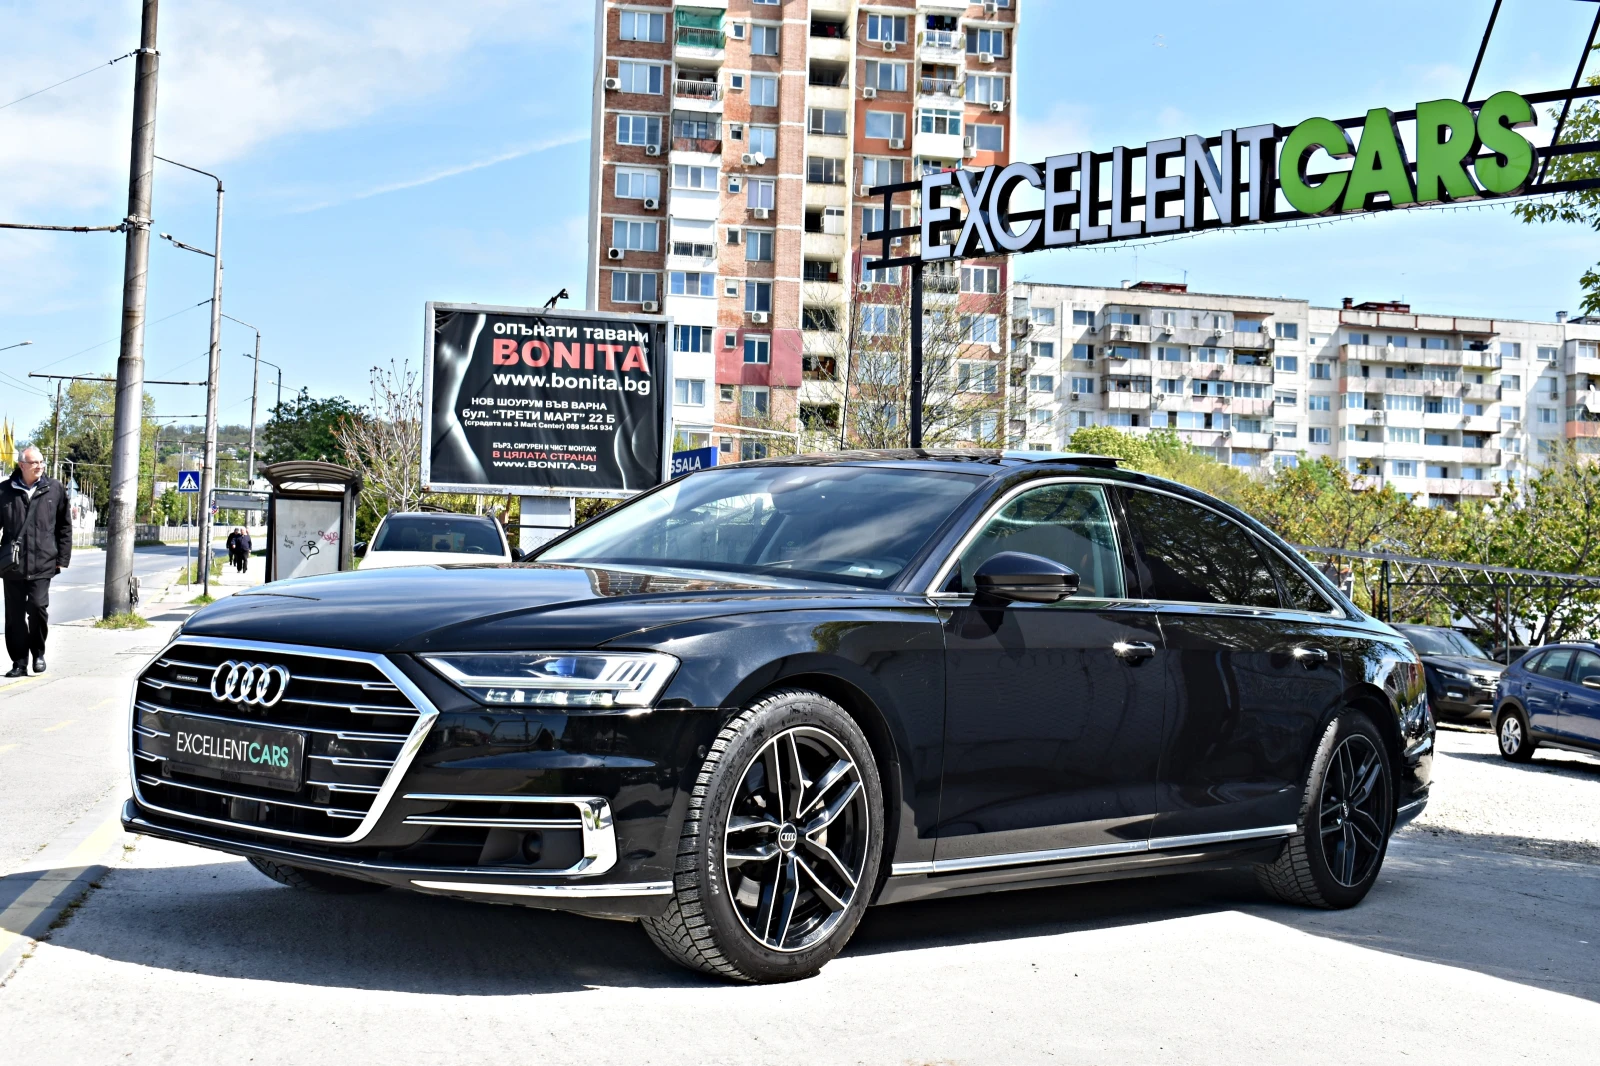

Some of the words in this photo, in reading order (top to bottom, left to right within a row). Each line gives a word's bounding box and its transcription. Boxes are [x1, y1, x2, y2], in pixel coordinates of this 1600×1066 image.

[493, 322, 578, 338] опънати
[583, 327, 649, 343] тавани
[492, 338, 649, 373] BONITA
[493, 373, 651, 395] www.bonita.bg
[471, 397, 494, 406] НОВ
[497, 398, 543, 408] ШОУРУМ
[545, 400, 568, 409] ВЪВ
[571, 402, 607, 410] ВАРНА
[462, 408, 489, 419] бул.
[589, 414, 603, 423] 22
[606, 414, 616, 424] Б
[538, 422, 565, 430] Center)
[492, 450, 500, 458] В
[503, 451, 548, 460] ЦЯЛАТА
[550, 452, 597, 461] СТРАНА!
[493, 461, 596, 471] www.BONITA.bg
